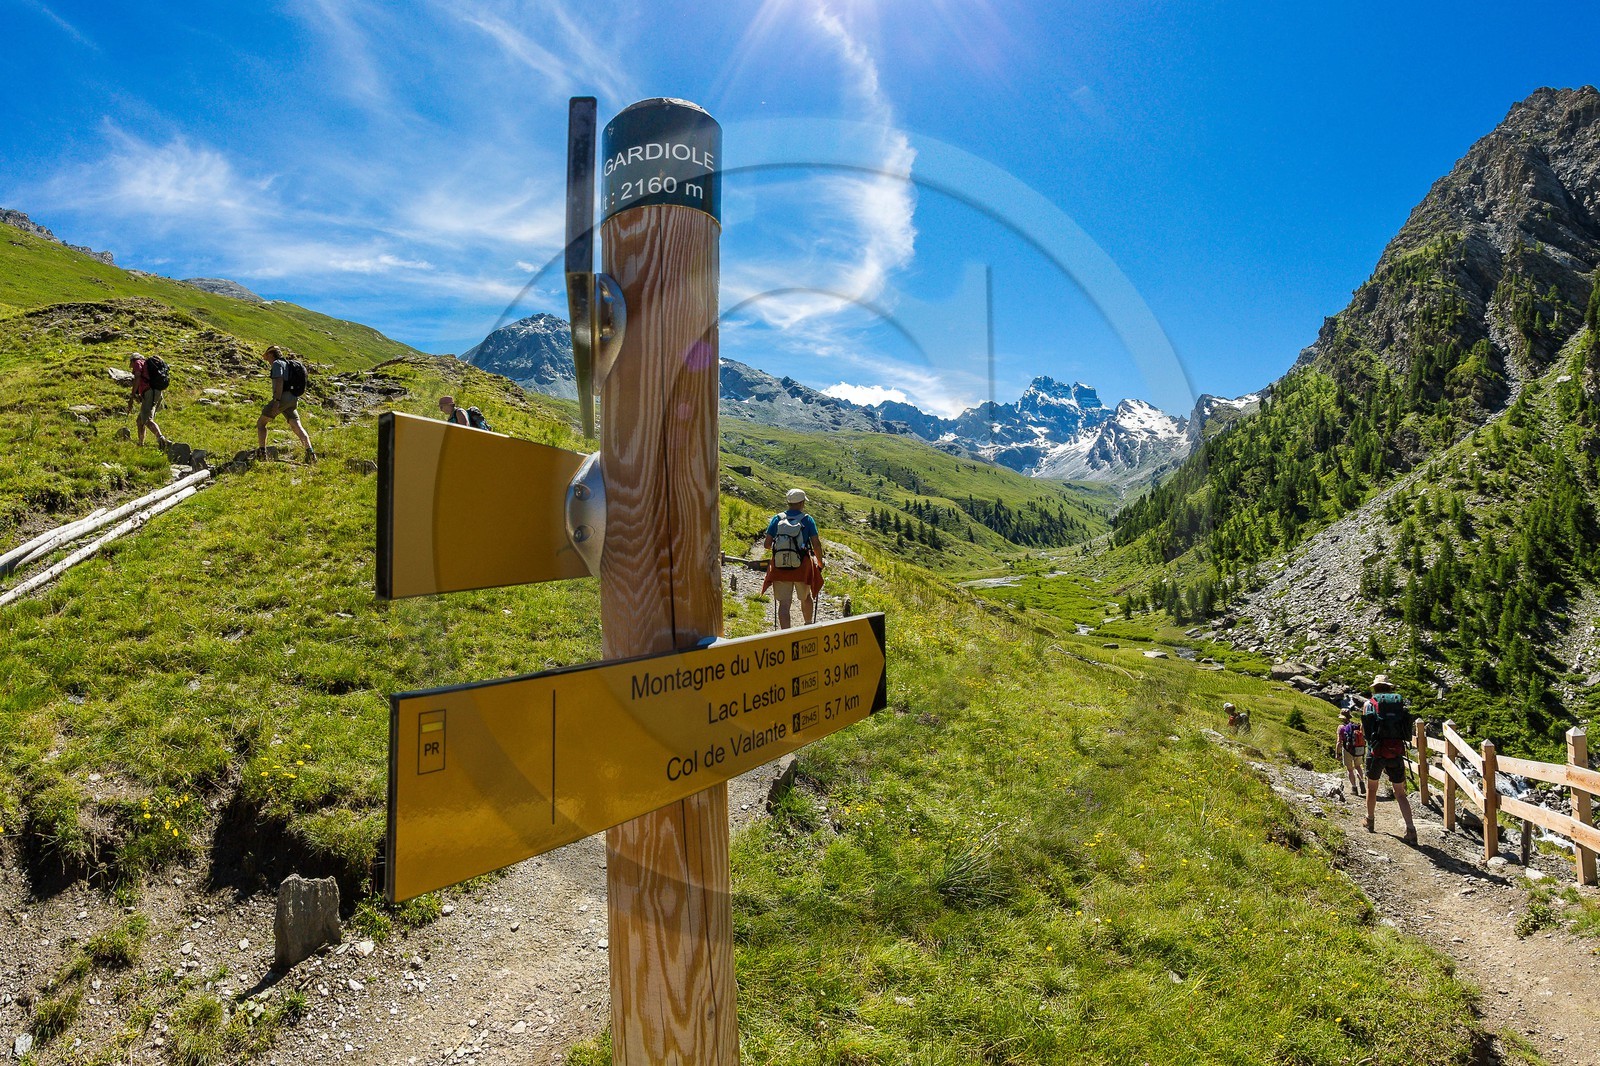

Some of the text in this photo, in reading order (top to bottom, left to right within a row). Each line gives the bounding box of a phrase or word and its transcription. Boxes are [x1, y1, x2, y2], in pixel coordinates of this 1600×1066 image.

[604, 142, 715, 177] GARDIOLE
[621, 176, 677, 201] 2160
[685, 182, 703, 200] m
[631, 630, 859, 700] Montagne du Viso 1h20 3,3 km
[708, 662, 859, 724] Lac Lestio 1h35 3,9 km
[423, 741, 440, 757] PR
[666, 694, 860, 781] Col de Valante 2h45 5,7 km
